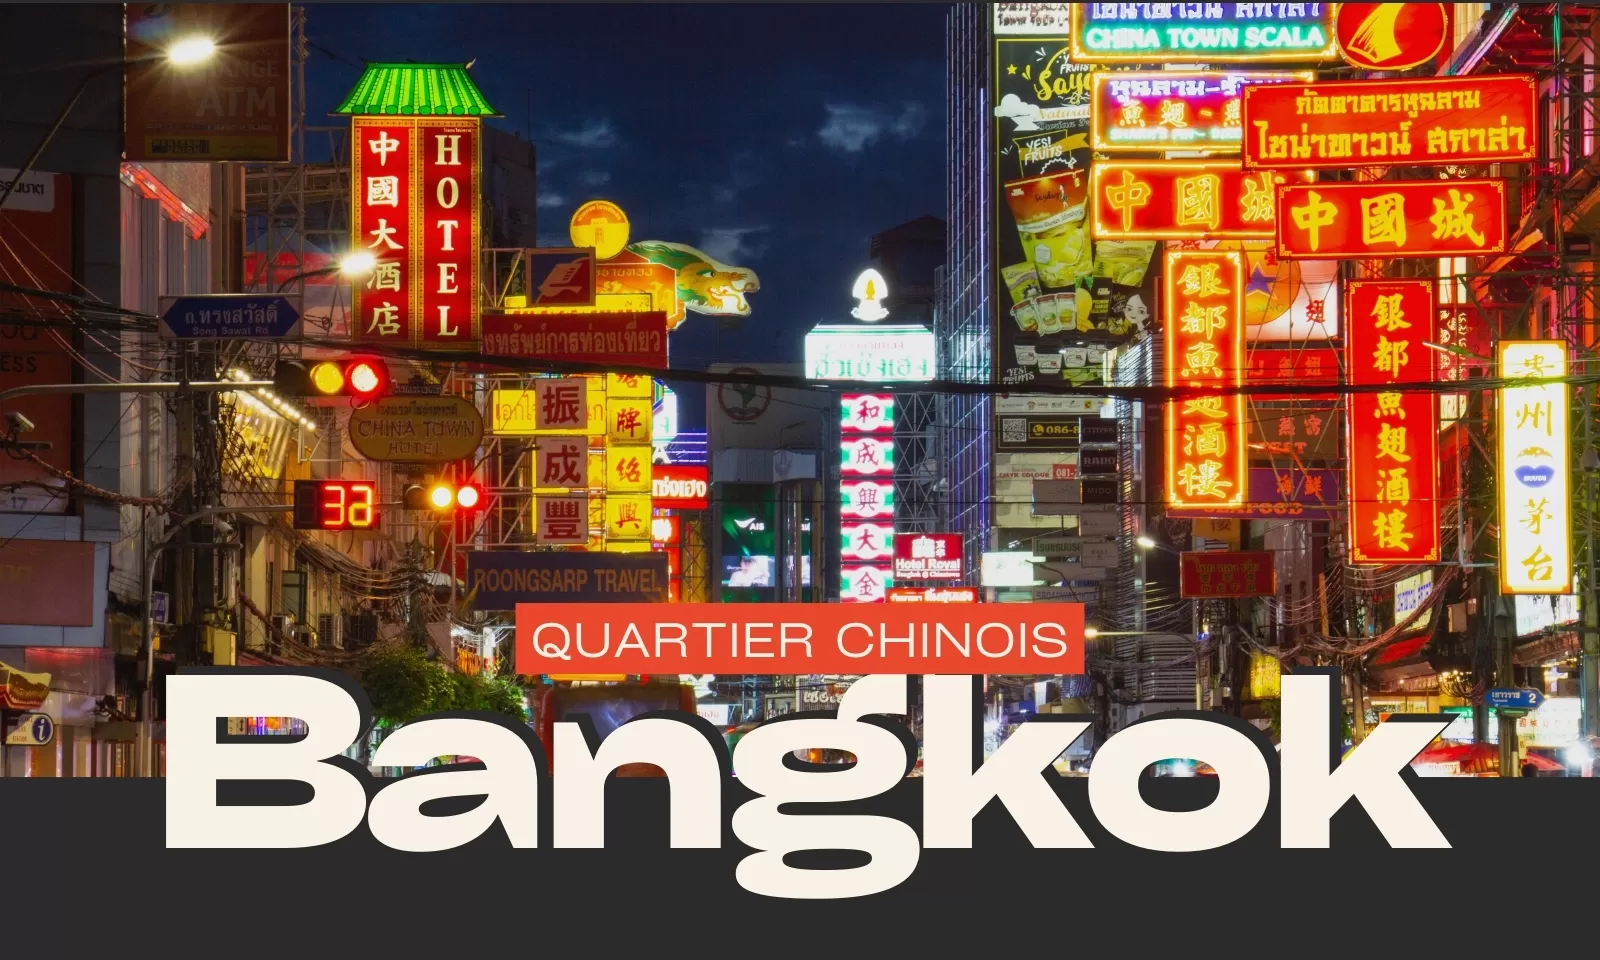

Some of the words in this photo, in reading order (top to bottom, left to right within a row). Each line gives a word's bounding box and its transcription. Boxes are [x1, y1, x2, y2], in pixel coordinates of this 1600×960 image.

[1086, 28, 1161, 49] CHINA
[1167, 27, 1239, 48] TOWN
[1244, 26, 1325, 48] SCALA
[196, 86, 277, 117] ATM
[1026, 136, 1052, 149] YES!
[1253, 121, 1411, 158] ไชน่าทาวน์
[1427, 115, 1526, 155] สกาล่า
[1024, 145, 1063, 166] FRUITS
[1291, 189, 1486, 252] 中國城
[366, 131, 404, 337] 中國大酒店
[434, 134, 462, 337] HOTEL
[193, 327, 218, 337] Song
[256, 327, 269, 336] Rd
[357, 420, 416, 437] CHINA
[423, 420, 475, 437] TOWN
[1370, 293, 1415, 552] 銀都魚翅酒樓
[387, 441, 444, 456] HOTEL
[542, 386, 581, 539] 振成豐
[1083, 456, 1116, 465] RADO
[856, 400, 881, 597] 和成興大金
[1087, 487, 1112, 495] MIDO
[749, 523, 765, 531] AIS
[1518, 497, 1553, 582] 茅台
[895, 558, 926, 569] Hotel
[927, 558, 961, 570] Royal
[474, 567, 588, 593] ROONGSARP
[594, 568, 662, 593] TRAVEL
[1528, 693, 1537, 704] 2
